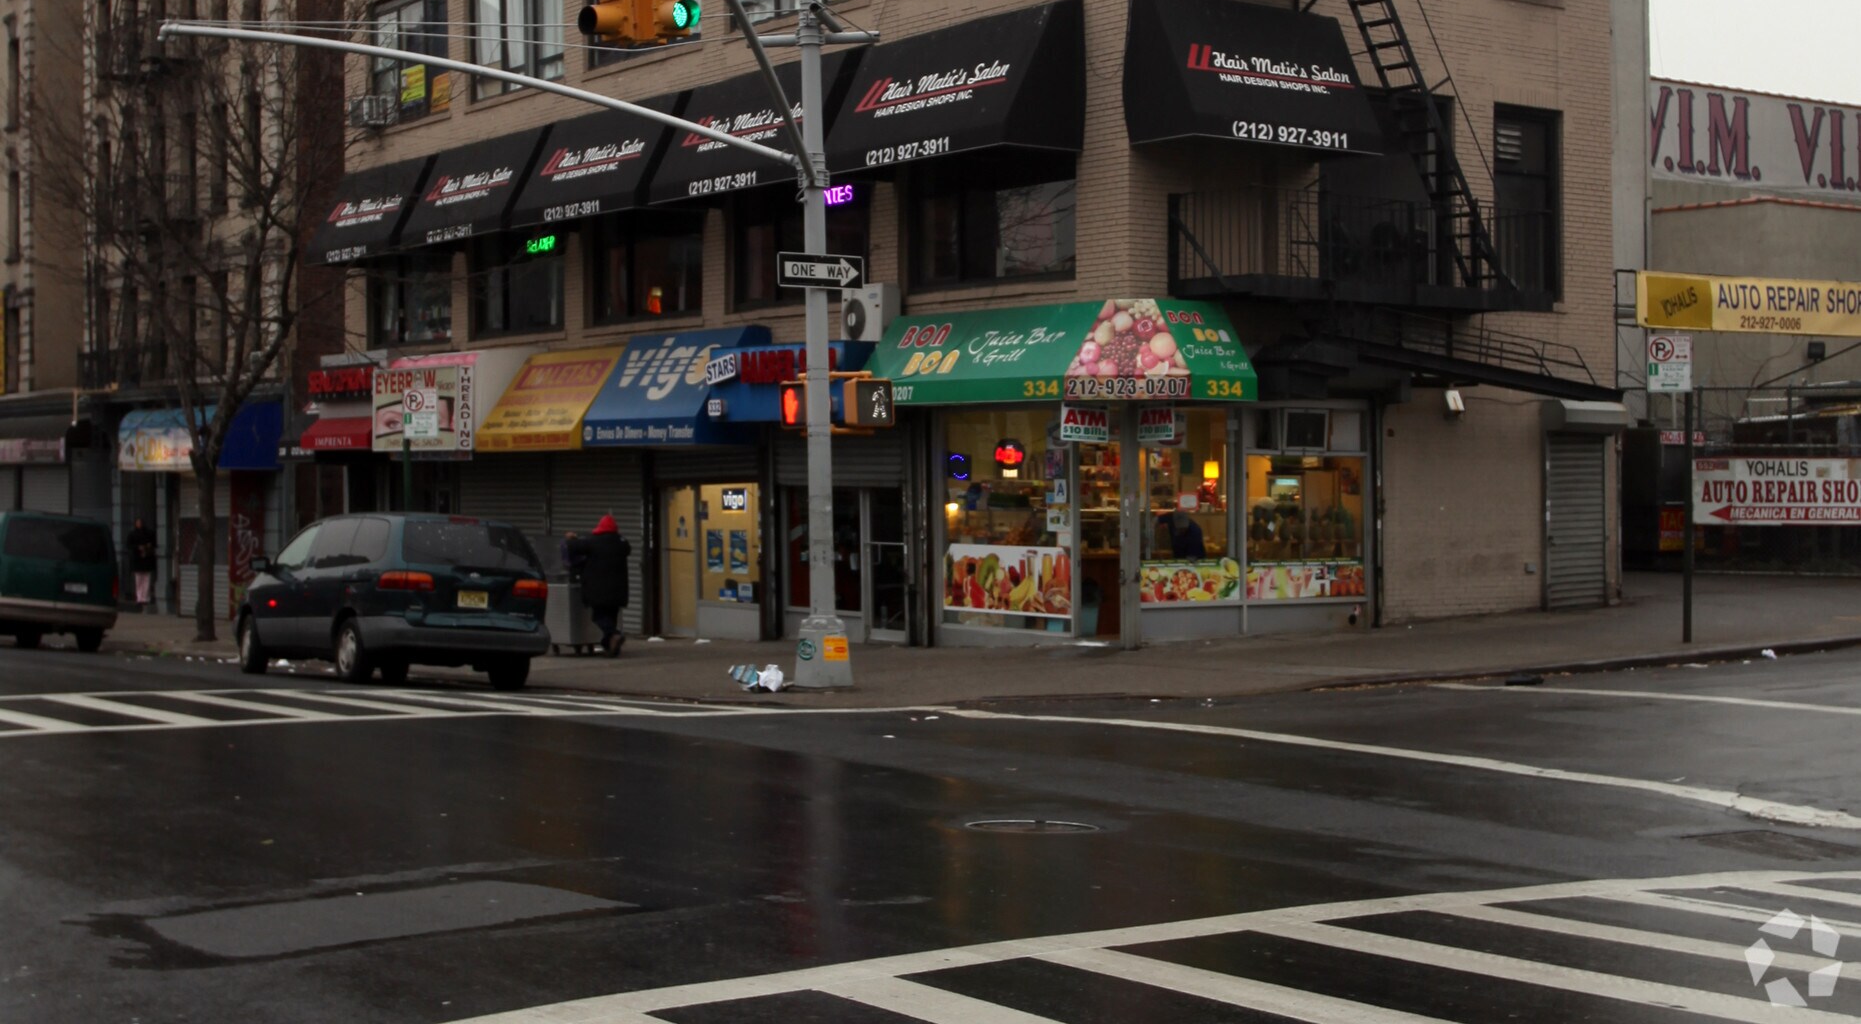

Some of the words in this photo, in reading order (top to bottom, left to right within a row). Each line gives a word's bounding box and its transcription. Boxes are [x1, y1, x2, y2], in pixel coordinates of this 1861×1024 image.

[1212, 51, 1249, 72] Hair
[1251, 57, 1309, 79] Matic's
[1311, 64, 1351, 84] Salon
[881, 79, 912, 102] Hair
[916, 68, 966, 94] Matic's
[967, 59, 1011, 85] Salon
[1219, 73, 1244, 84] HAIR
[1244, 76, 1279, 89] DESIGN
[1280, 80, 1311, 93] SHOPS
[1312, 84, 1331, 95] INC.
[873, 106, 894, 118] HAIR
[894, 98, 925, 114] DESIGN
[926, 92, 956, 107] SHOPS
[732, 109, 774, 132] Matic's
[1232, 120, 1273, 141] (212)
[1277, 125, 1348, 149] 927-3911
[865, 147, 895, 166] (212)
[897, 136, 950, 160] 927-3911
[1787, 103, 1861, 191] V.I.
[688, 178, 712, 196] (212)
[714, 170, 757, 190] 927-3911
[564, 199, 600, 218] 927-3911
[792, 264, 816, 277] ONE
[827, 266, 851, 278] WAY
[1661, 286, 1698, 319] YOHALIS
[1718, 284, 1760, 310] AUTO
[1766, 286, 1819, 313] REPAIR
[1740, 316, 1801, 330] 212-927-0006
[968, 330, 1024, 355] Juice
[1025, 326, 1066, 344] Bar
[982, 349, 1026, 366] Grill
[1182, 343, 1213, 359] Juice
[1214, 345, 1236, 356] Bar
[619, 337, 721, 400] vigo
[706, 356, 735, 381] STARS
[1023, 379, 1059, 396] 334
[1067, 378, 1188, 396] 212-923-0207
[1207, 379, 1243, 396] 334
[461, 367, 470, 448] THREADING
[1140, 409, 1172, 425] ATM
[1064, 409, 1107, 427] ATM
[615, 427, 624, 439] De
[624, 425, 643, 439] Dinero
[648, 425, 667, 442] Money
[668, 424, 694, 439] Transfer
[1063, 426, 1081, 434] $10
[1083, 426, 1107, 436] Bills
[313, 436, 352, 446] IMPRENTA
[1746, 460, 1808, 477] YOHALIS
[1056, 482, 1065, 496] A
[1702, 480, 1747, 503] AUTO
[1752, 480, 1818, 503] REPAIR
[1822, 479, 1861, 503] SHO
[723, 490, 744, 509] vigo
[1729, 507, 1788, 520] MECANICA
[1790, 507, 1804, 520] EN
[1808, 507, 1860, 520] GENERAL
